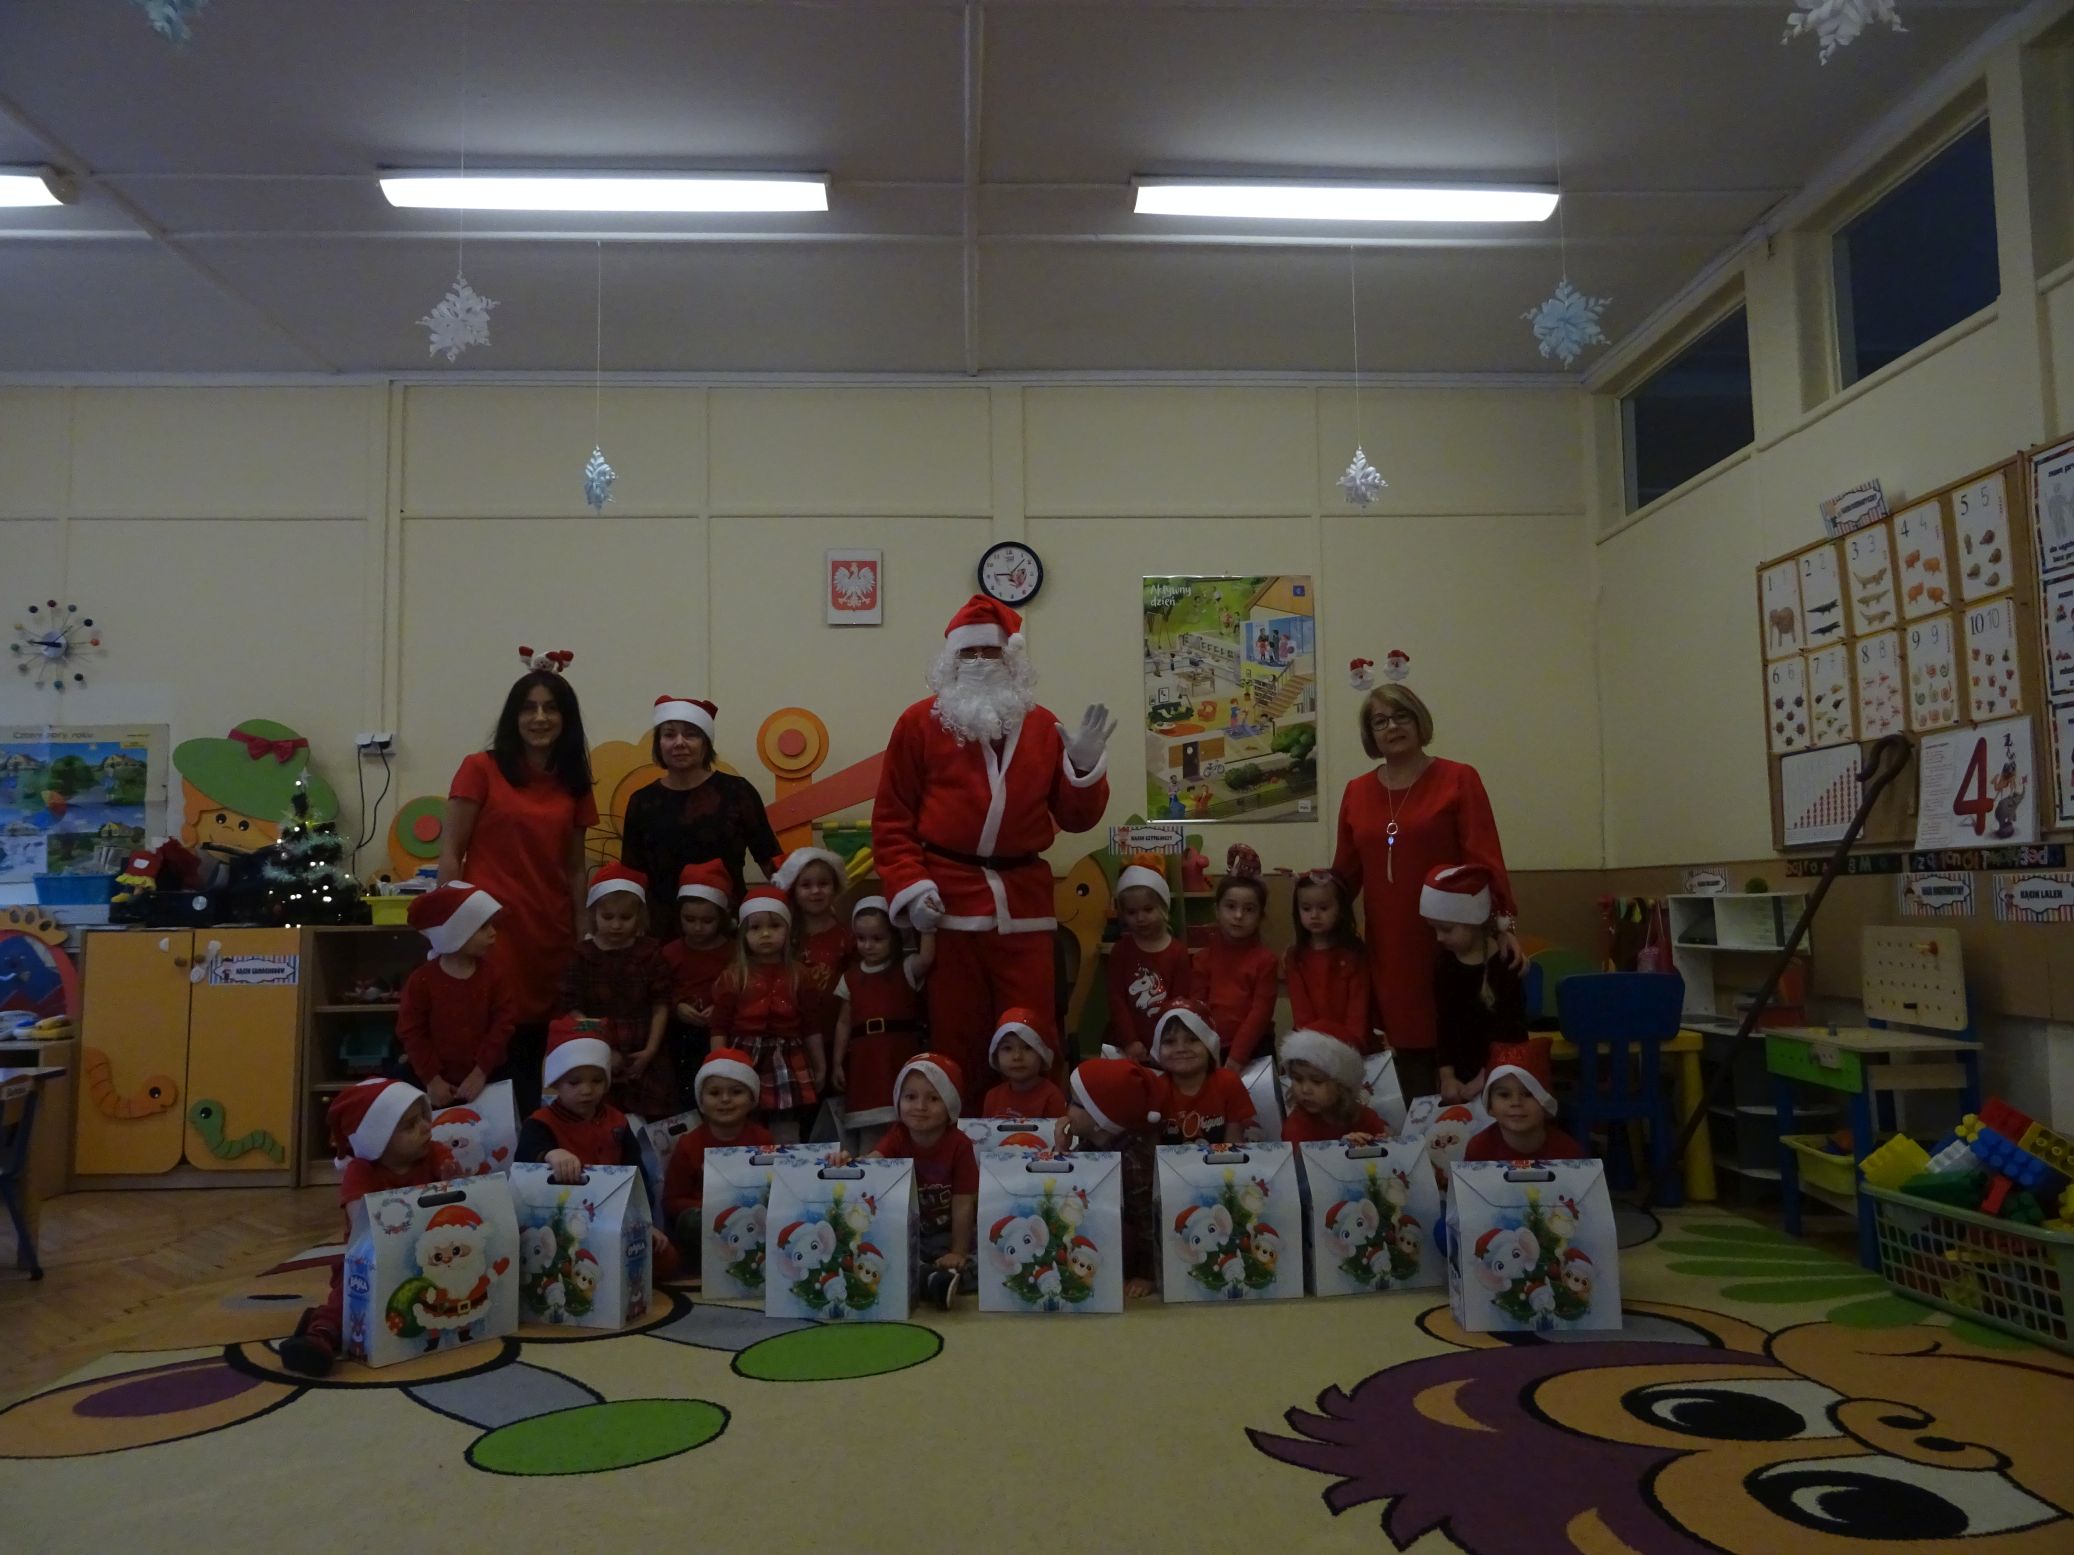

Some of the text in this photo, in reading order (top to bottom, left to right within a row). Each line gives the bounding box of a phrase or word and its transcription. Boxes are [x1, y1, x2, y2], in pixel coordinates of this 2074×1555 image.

[1961, 494, 1969, 516] 5
[1901, 520, 1910, 537] 4
[1851, 541, 1859, 561] 3
[1804, 559, 1813, 577] 2
[1151, 583, 1192, 597] Aktywny
[1151, 595, 1176, 608] dzień
[1970, 612, 1984, 636] 10
[1912, 630, 1920, 651] 9
[1861, 644, 1870, 664] 8
[1772, 665, 1780, 685] 6
[1813, 656, 1820, 675] 7
[1953, 736, 1994, 836] 4
[2040, 889, 2063, 899] LALEK
